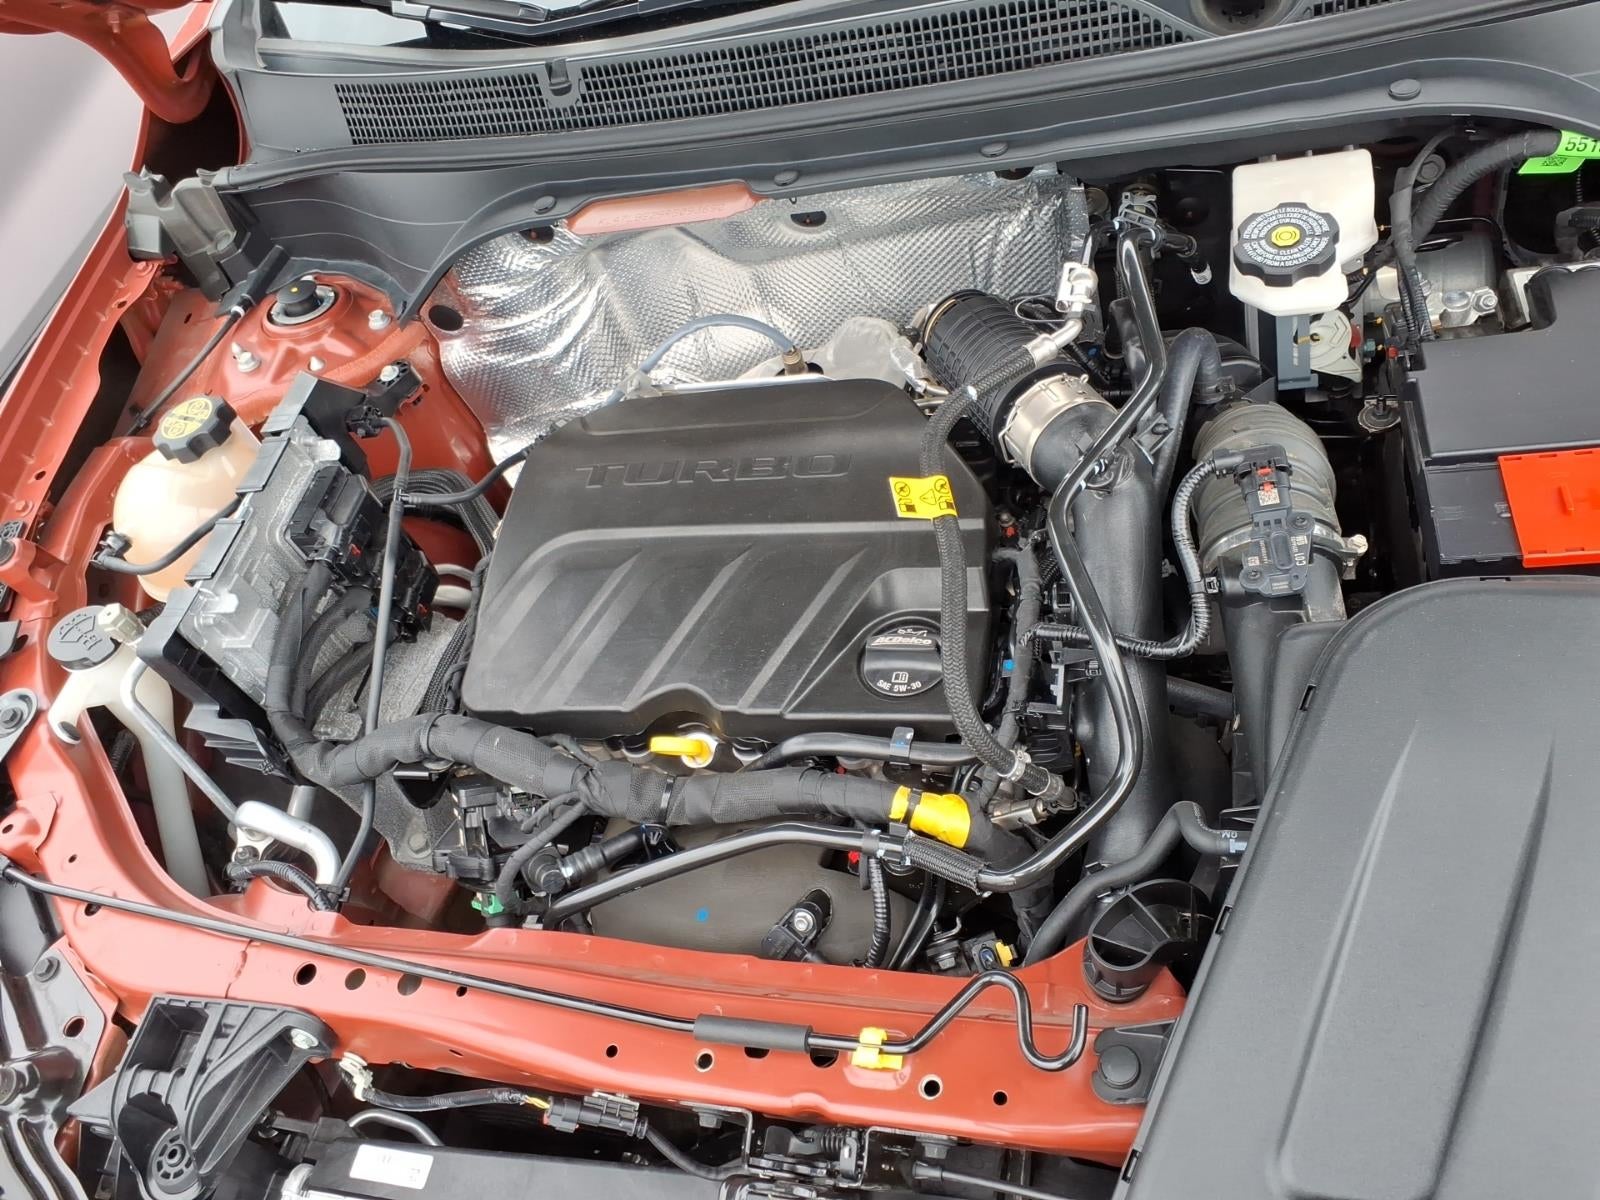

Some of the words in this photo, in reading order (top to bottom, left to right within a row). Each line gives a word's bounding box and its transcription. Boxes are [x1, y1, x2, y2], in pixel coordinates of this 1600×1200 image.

[1565, 137, 1600, 152] 551
[575, 453, 852, 488] TURBO
[871, 635, 933, 646] ACDelco
[876, 679, 892, 691] SAE
[893, 681, 922, 692] 5W-30
